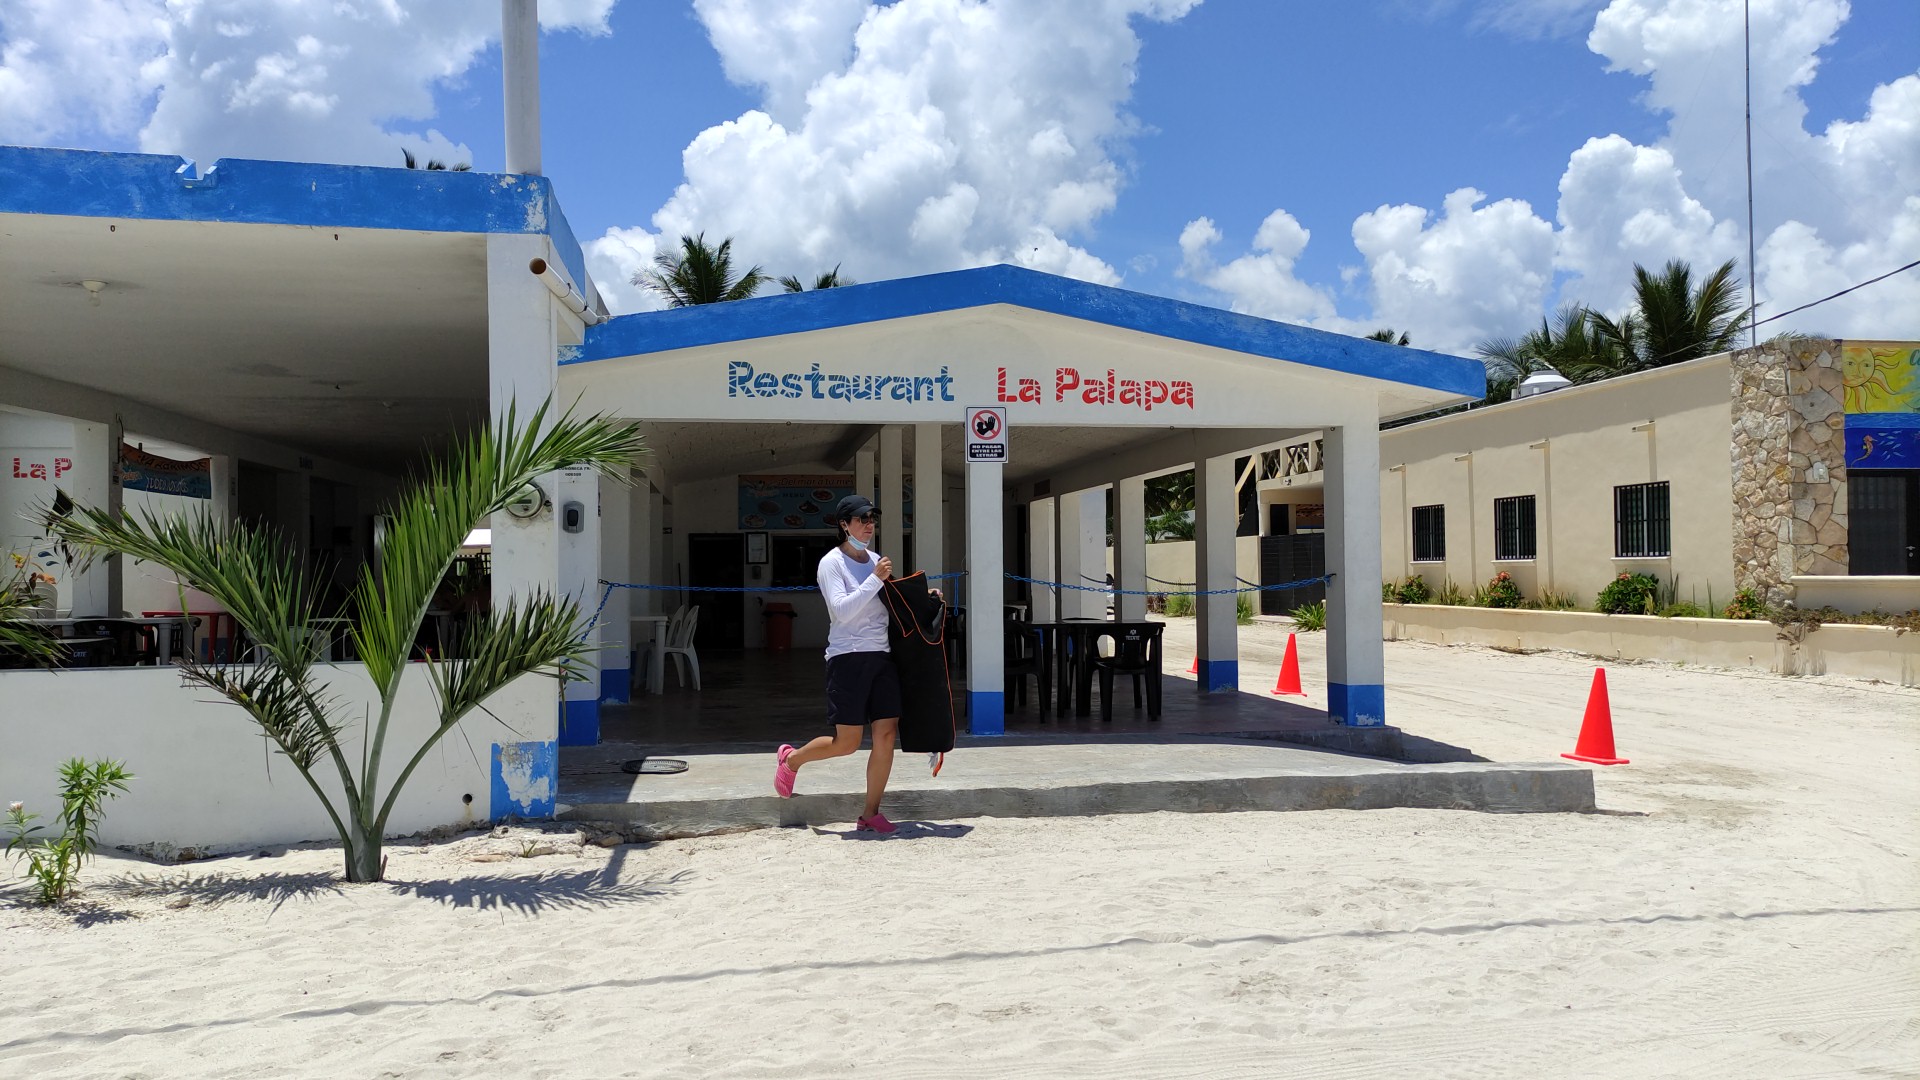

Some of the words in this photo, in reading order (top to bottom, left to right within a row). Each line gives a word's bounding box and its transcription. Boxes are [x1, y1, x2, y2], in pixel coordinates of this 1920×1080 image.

[728, 360, 955, 404] Restaurant
[997, 367, 1041, 405] La
[1055, 367, 1194, 411] Palapa
[13, 457, 47, 481] La
[54, 457, 73, 478] P
